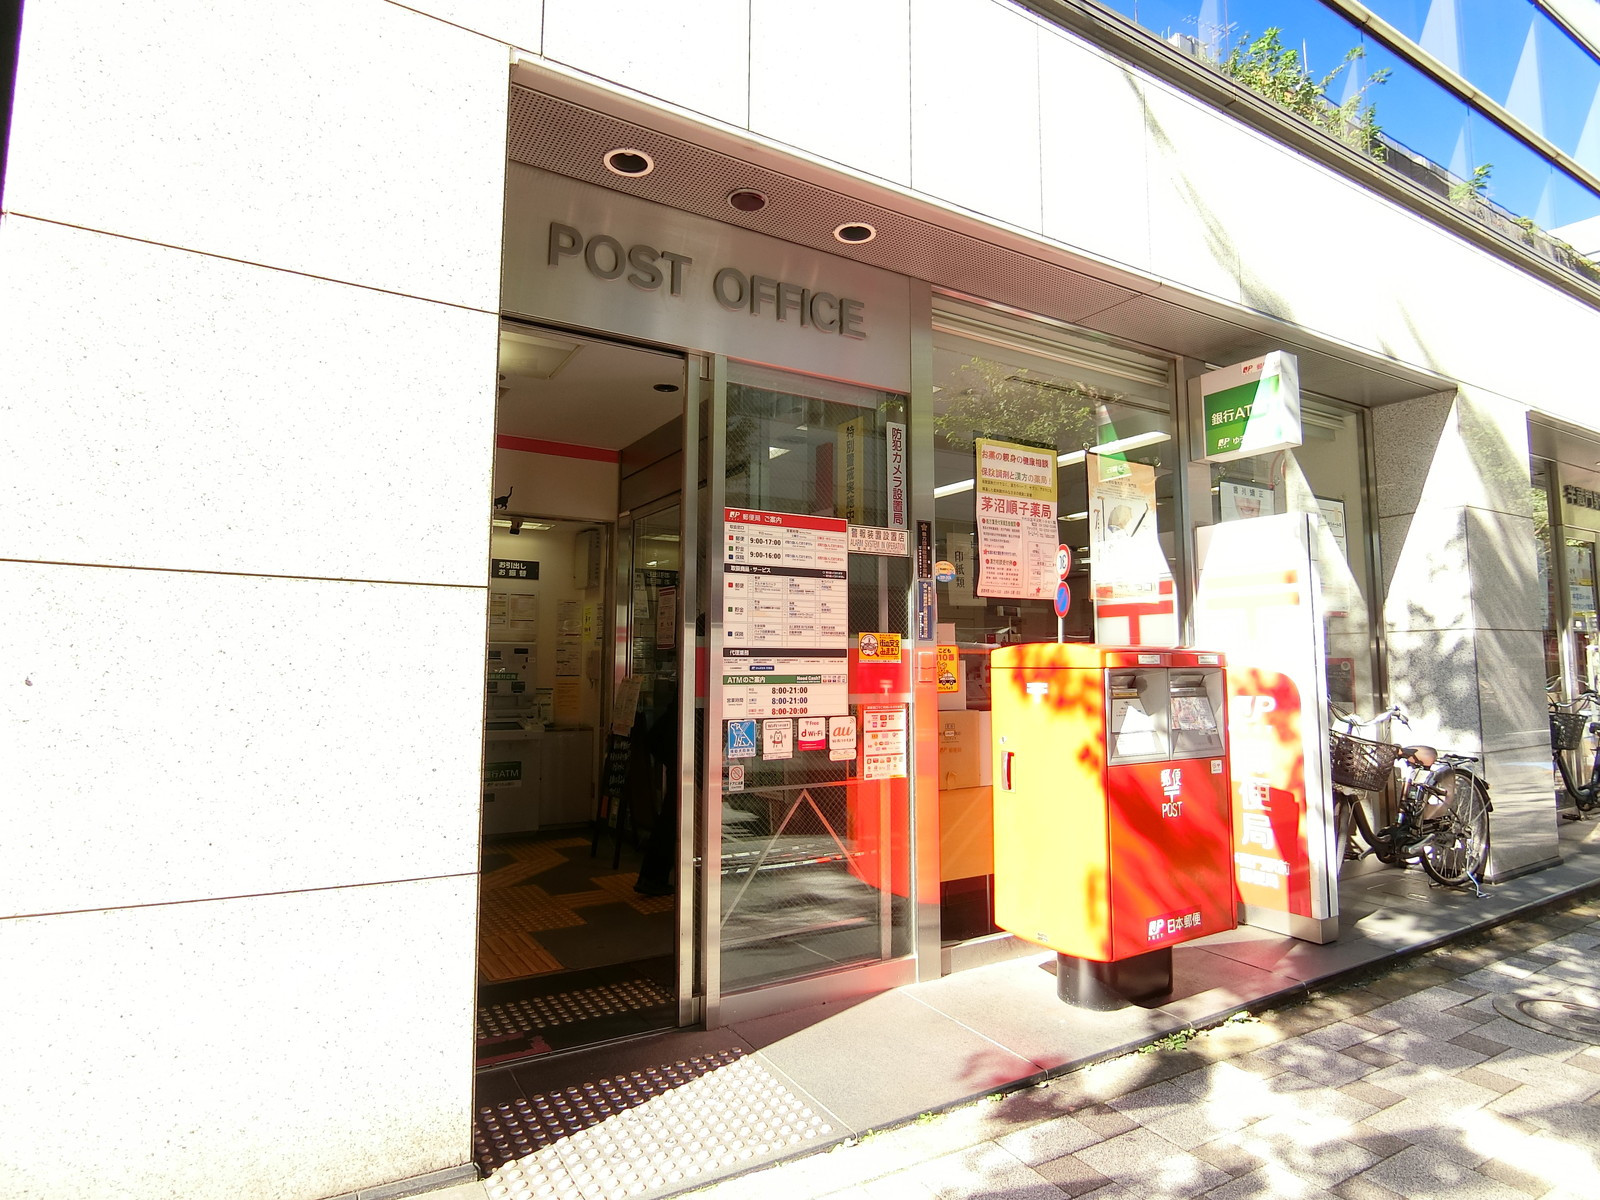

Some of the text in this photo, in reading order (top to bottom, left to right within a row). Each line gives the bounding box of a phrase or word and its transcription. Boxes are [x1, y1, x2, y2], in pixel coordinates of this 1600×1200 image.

[548, 221, 868, 341] POST OFFICE
[1211, 404, 1253, 426] 銀行AT
[981, 450, 1049, 468] お薬の親身の健康相談
[892, 427, 904, 526] 防犯カメラ設置局
[981, 496, 1052, 519] 茅沼順子薬局
[764, 515, 782, 524] ご案内
[851, 527, 905, 542] 警報装置設置店
[750, 537, 781, 546] 9:00-17:00
[850, 539, 864, 547] ALARM
[864, 540, 880, 549] SYSTEM
[886, 541, 905, 551] OPERATION
[750, 551, 781, 560] 9:00-16:00
[498, 561, 527, 570] お引出し
[771, 686, 808, 694] 8:00-21:00
[771, 697, 808, 705] 8:00-21:00
[771, 707, 808, 715] 8:00-20:00
[833, 726, 853, 737] au
[1160, 768, 1182, 787] 郵便
[1161, 801, 1183, 818] POST
[1167, 912, 1201, 934] 日本郵便
